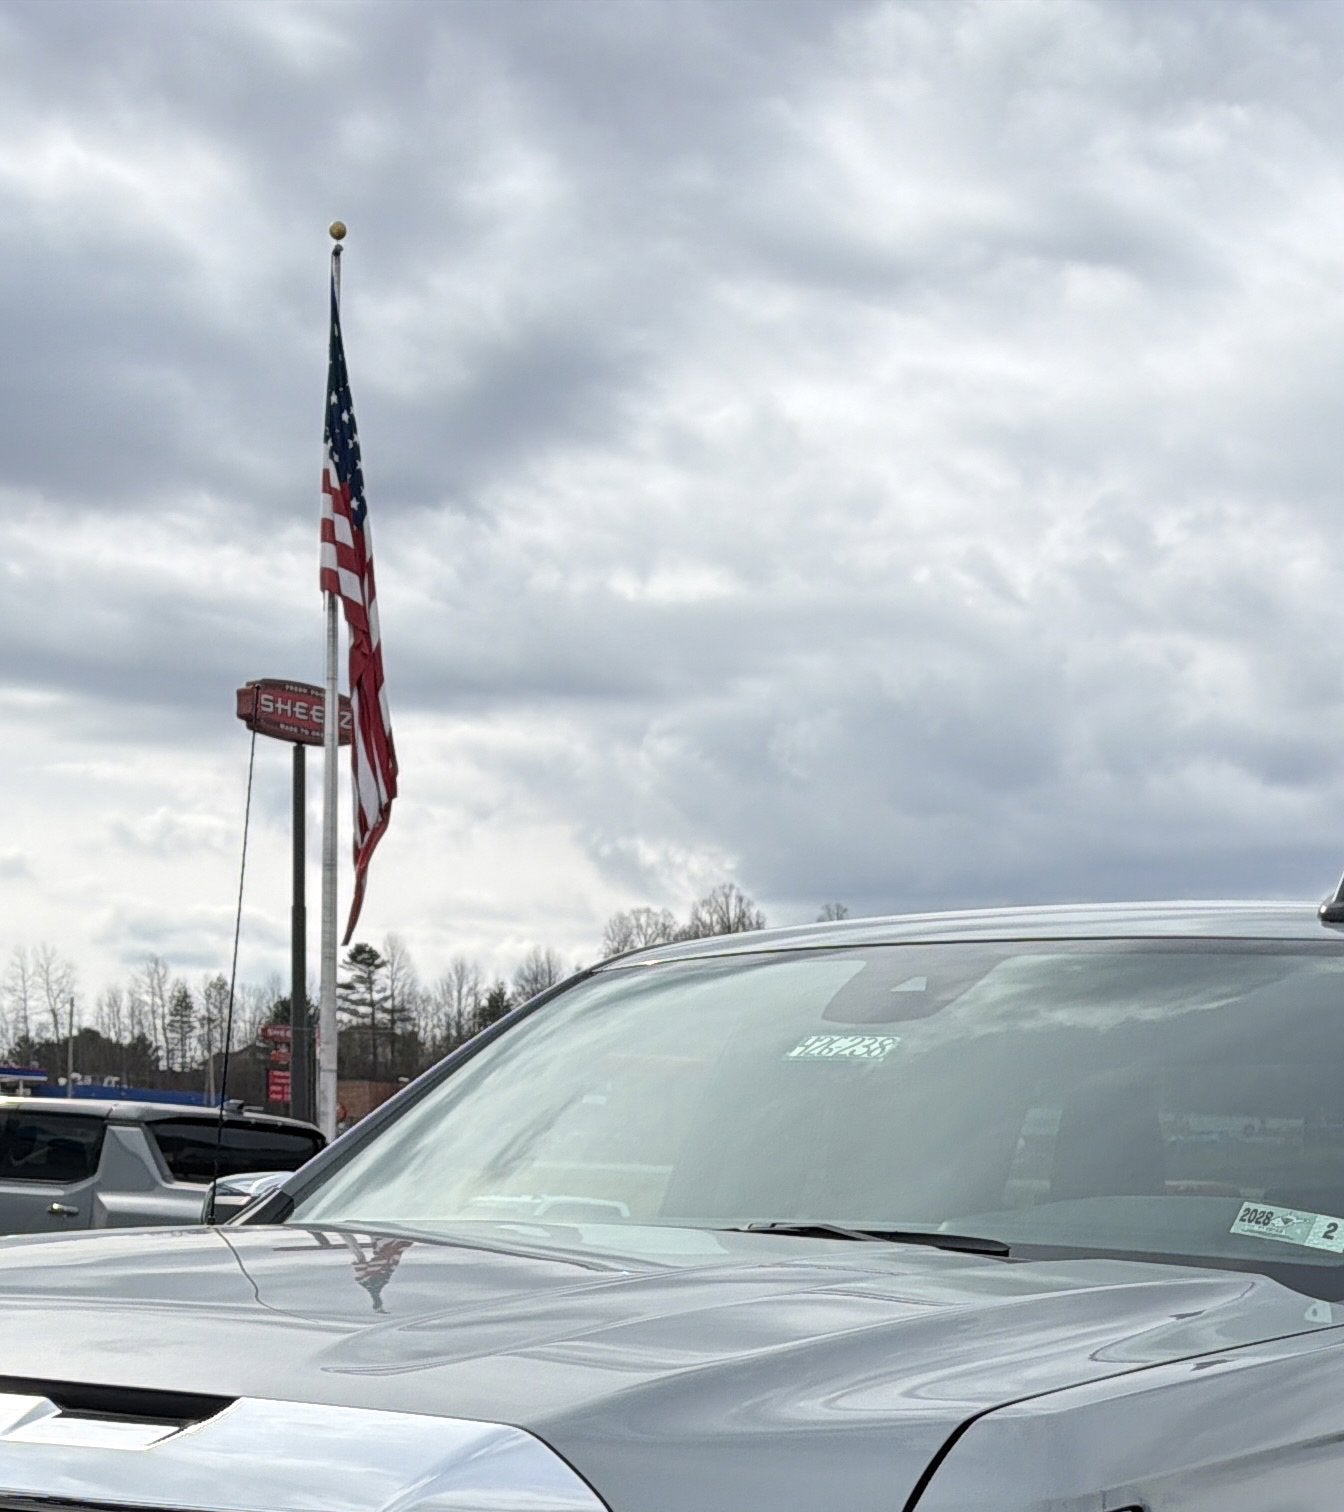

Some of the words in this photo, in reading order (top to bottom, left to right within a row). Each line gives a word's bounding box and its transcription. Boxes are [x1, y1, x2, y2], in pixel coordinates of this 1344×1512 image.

[260, 694, 352, 730] SHEEZ
[1239, 1207, 1274, 1226] 2028
[1321, 1222, 1339, 1240] 2
